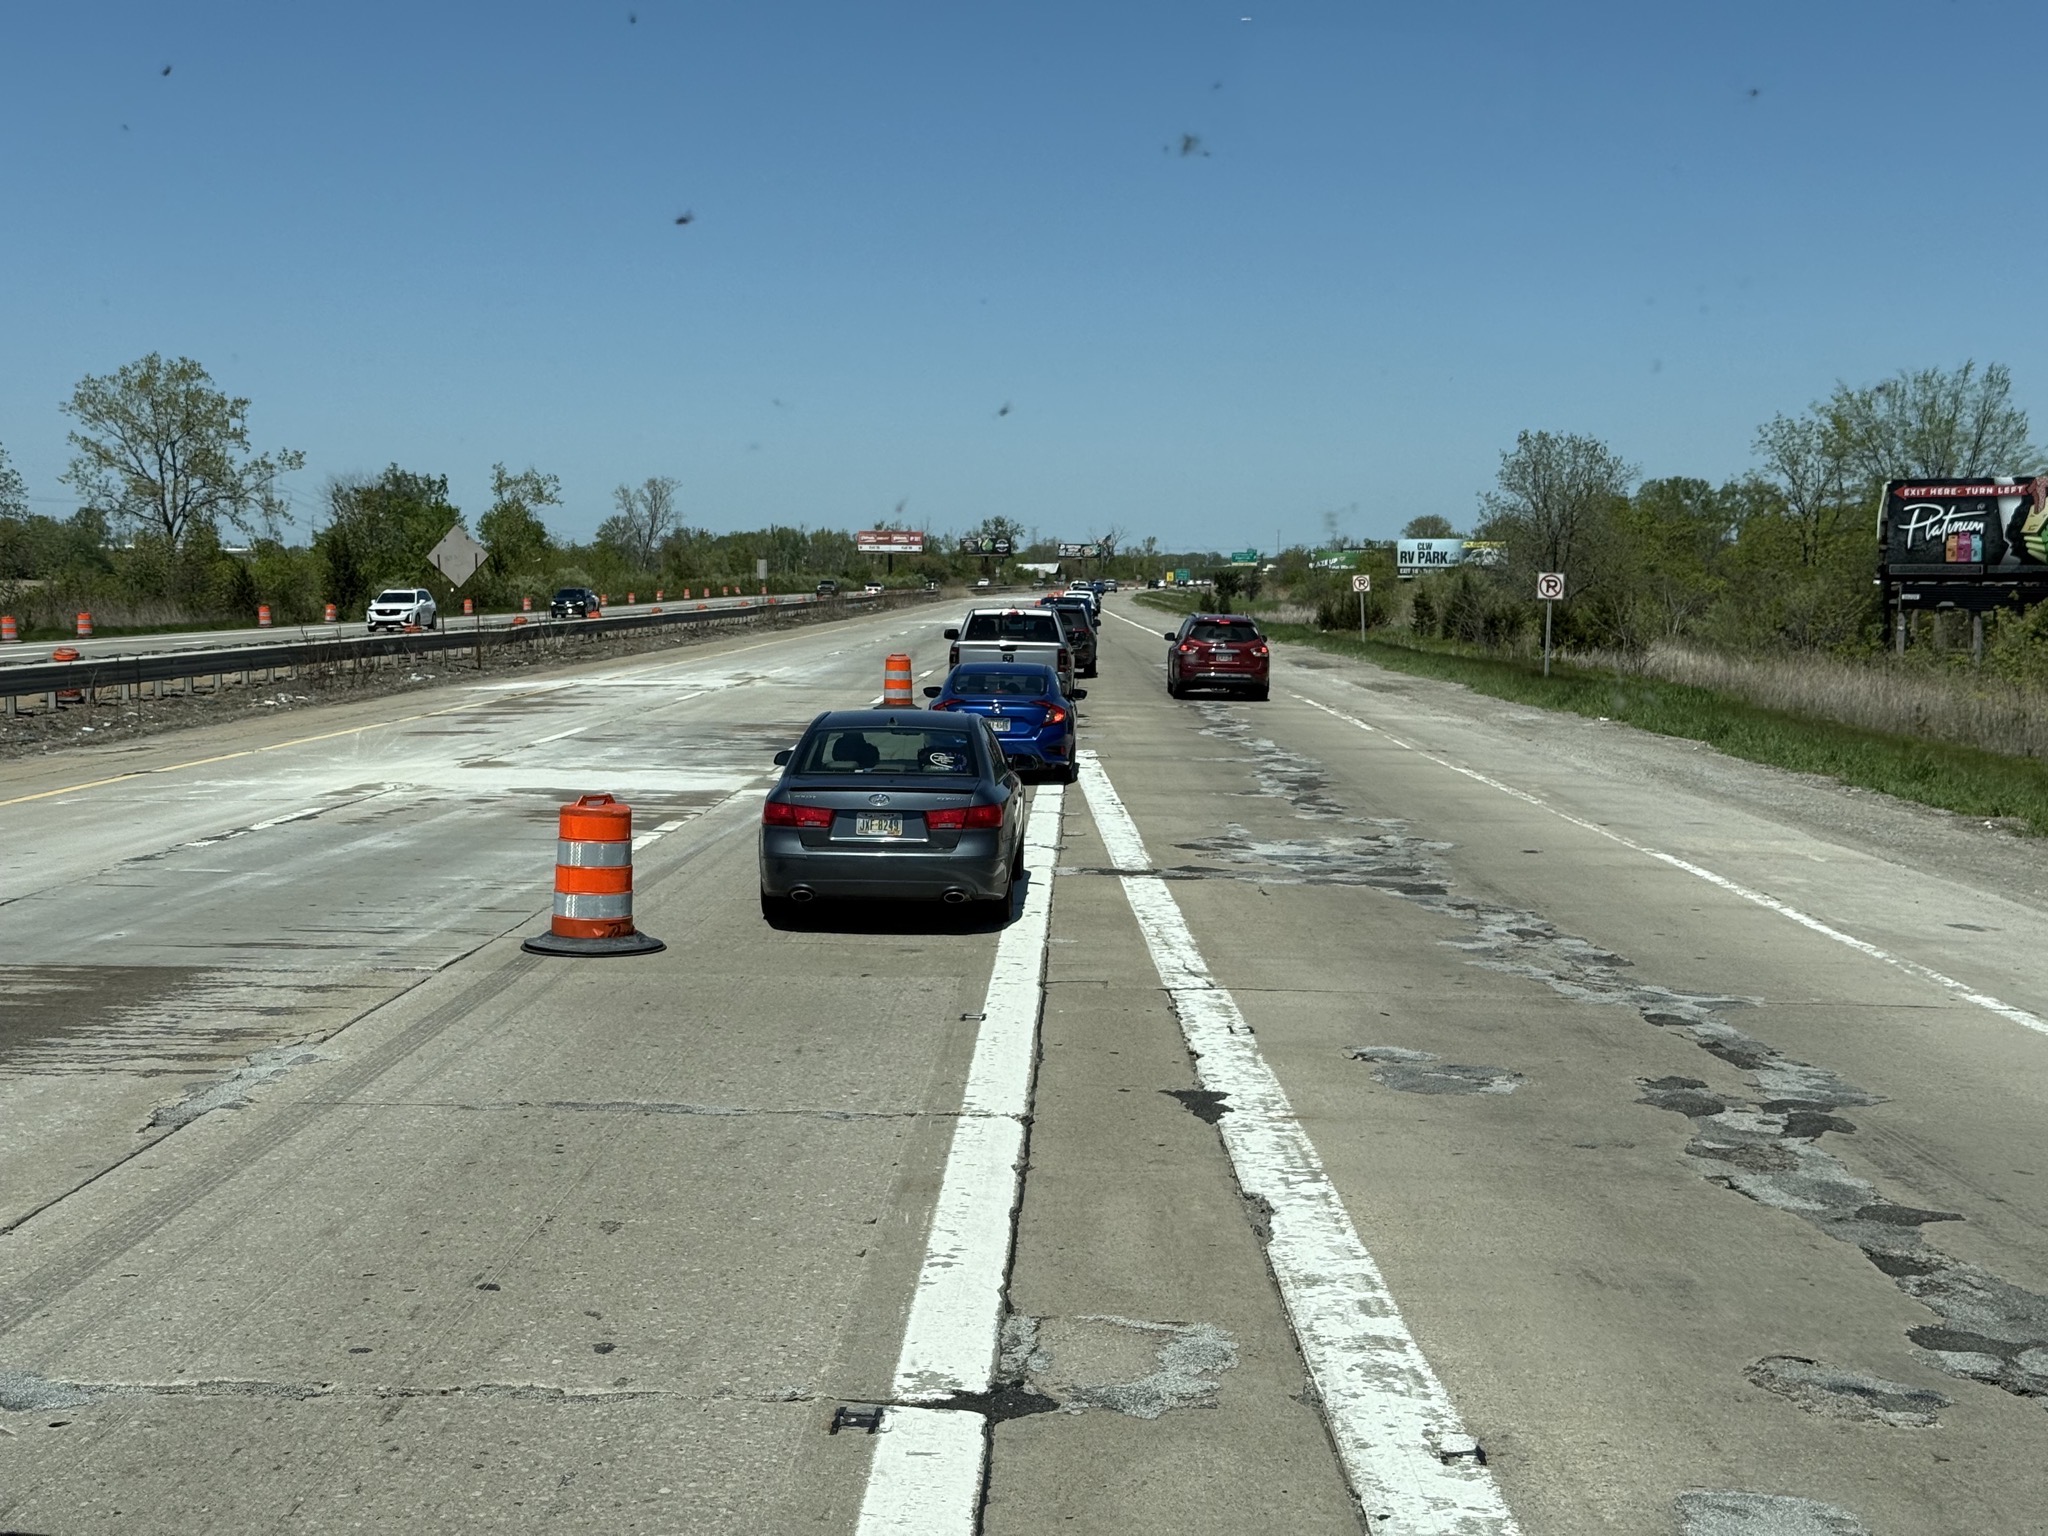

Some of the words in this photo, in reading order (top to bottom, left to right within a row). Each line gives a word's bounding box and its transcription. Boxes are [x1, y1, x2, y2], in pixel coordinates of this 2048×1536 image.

[1903, 488, 1927, 496] EXIT
[1966, 487, 1993, 495] TURN
[1997, 486, 2023, 494] LEFT
[1898, 503, 1987, 549] Platinum
[1400, 551, 1414, 564] RV
